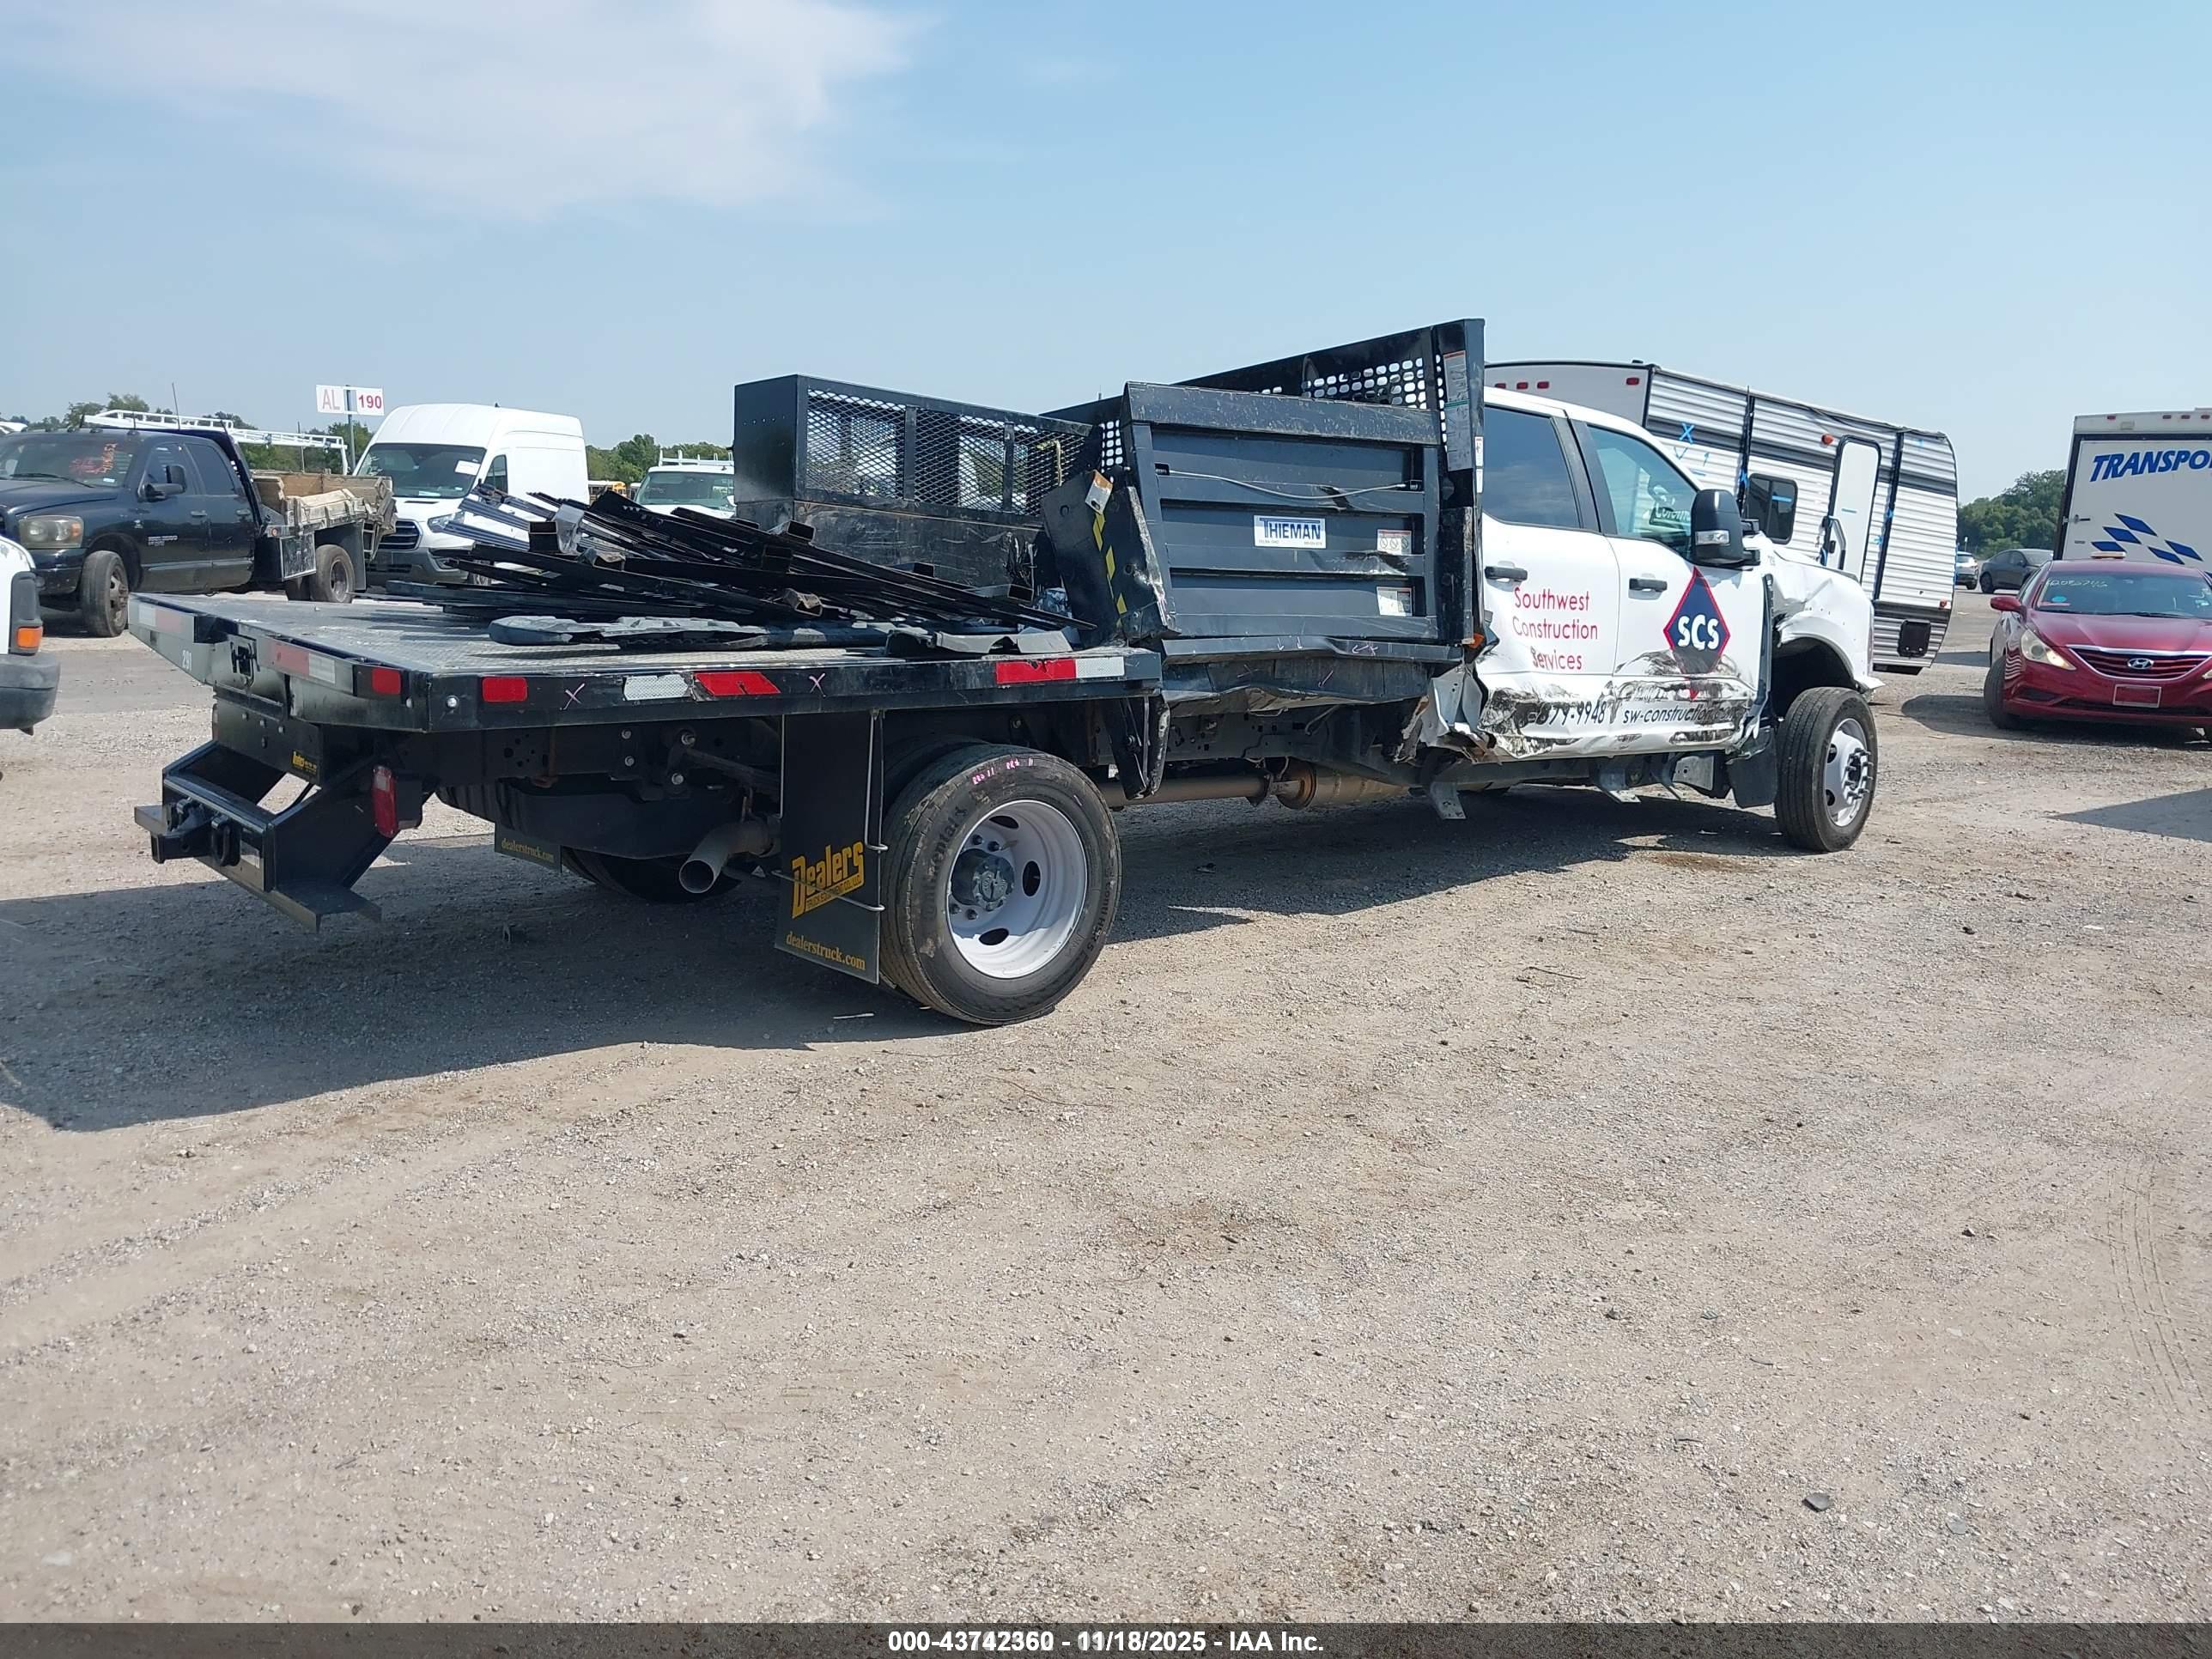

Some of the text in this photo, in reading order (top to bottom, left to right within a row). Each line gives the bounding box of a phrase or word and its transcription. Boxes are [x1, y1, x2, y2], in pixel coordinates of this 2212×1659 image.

[322, 389, 340, 410] AL
[358, 394, 382, 410] 190
[2089, 450, 2212, 482] TRANSPO
[1260, 518, 1322, 540] THIEMAN
[1514, 586, 1589, 611] Southwest
[1512, 616, 1598, 640] Construction
[1677, 614, 1719, 651] SCS
[1530, 646, 1583, 671] Services
[1623, 704, 1733, 724] sw-construction
[792, 842, 865, 919] Dealers
[786, 930, 866, 970] dealerstruck.com
